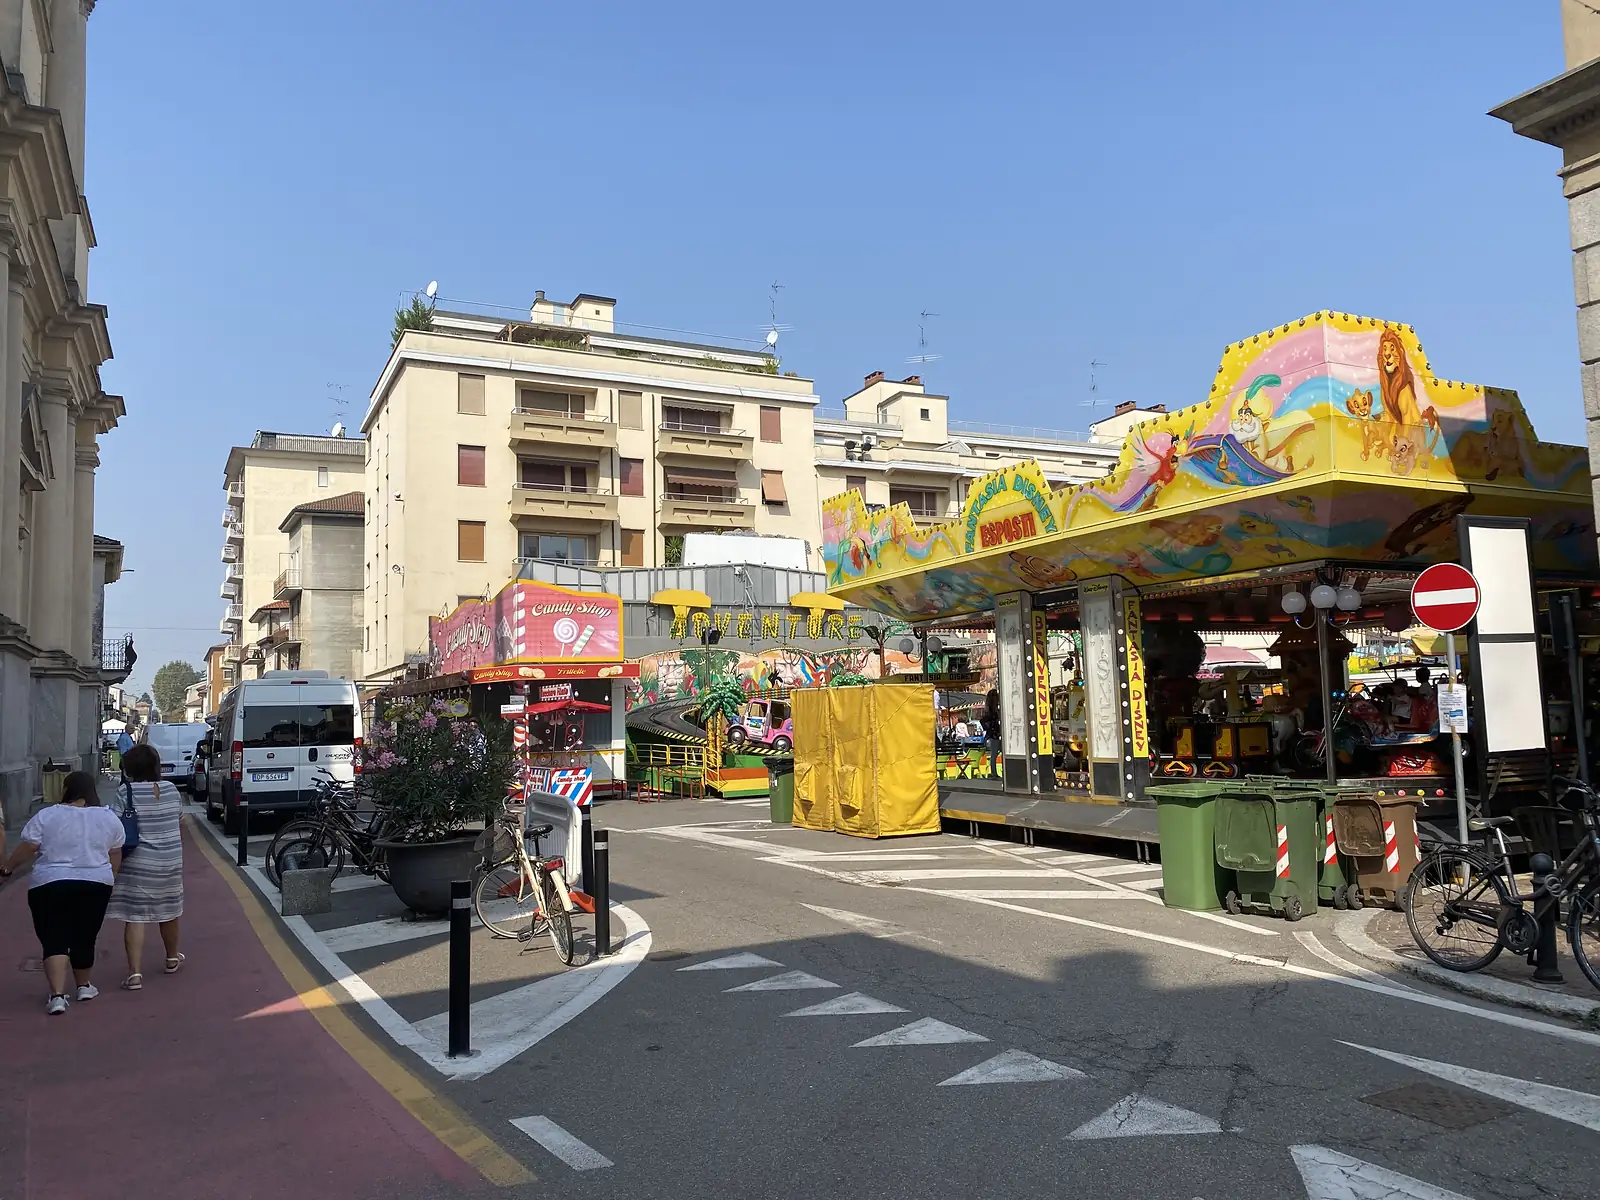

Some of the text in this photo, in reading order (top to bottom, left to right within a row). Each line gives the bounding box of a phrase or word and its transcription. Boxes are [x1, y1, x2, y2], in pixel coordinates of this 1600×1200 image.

[965, 474, 1058, 553] FANTASIA DISNEY
[980, 512, 1036, 548] ESPOSTI
[531, 600, 612, 618] Candy Shop
[670, 612, 864, 640] ADVENTURE
[904, 674, 940, 683] FANTSIA
[1035, 615, 1048, 750] BENVENUTI
[1127, 600, 1146, 752] FANTASIA DISNEY
